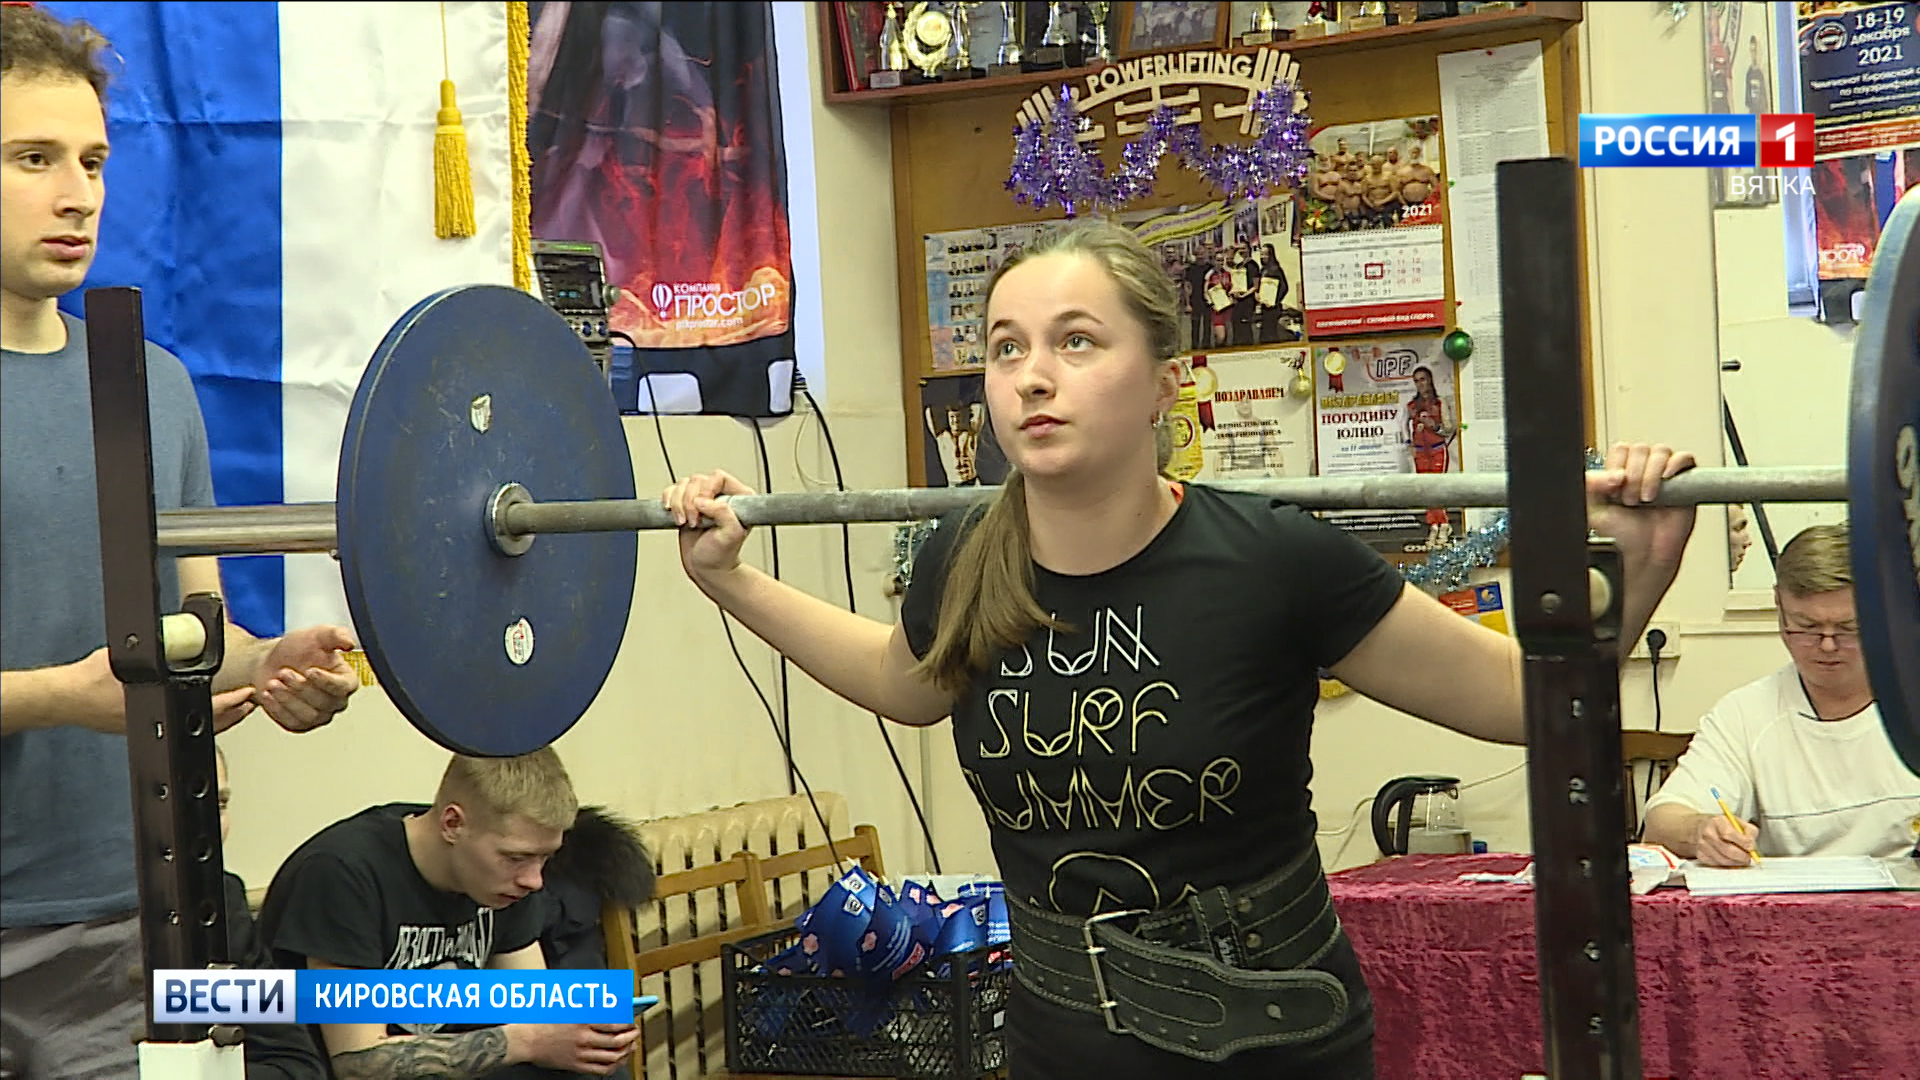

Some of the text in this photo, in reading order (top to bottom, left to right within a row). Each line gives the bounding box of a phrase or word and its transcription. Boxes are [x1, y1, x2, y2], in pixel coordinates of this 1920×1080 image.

[1855, 7, 1905, 30] 18-19
[1858, 44, 1904, 66] 2021
[1086, 51, 1253, 96] POWERLIFTING
[1401, 203, 1433, 219] 2021
[673, 282, 776, 318] ПРОСТОР
[1376, 355, 1412, 378] IPF
[1321, 409, 1398, 425] ПОГОДИНУ
[1337, 427, 1384, 440] ЮЛИЮ
[1001, 605, 1160, 677] SUN
[980, 681, 1180, 758] SURF
